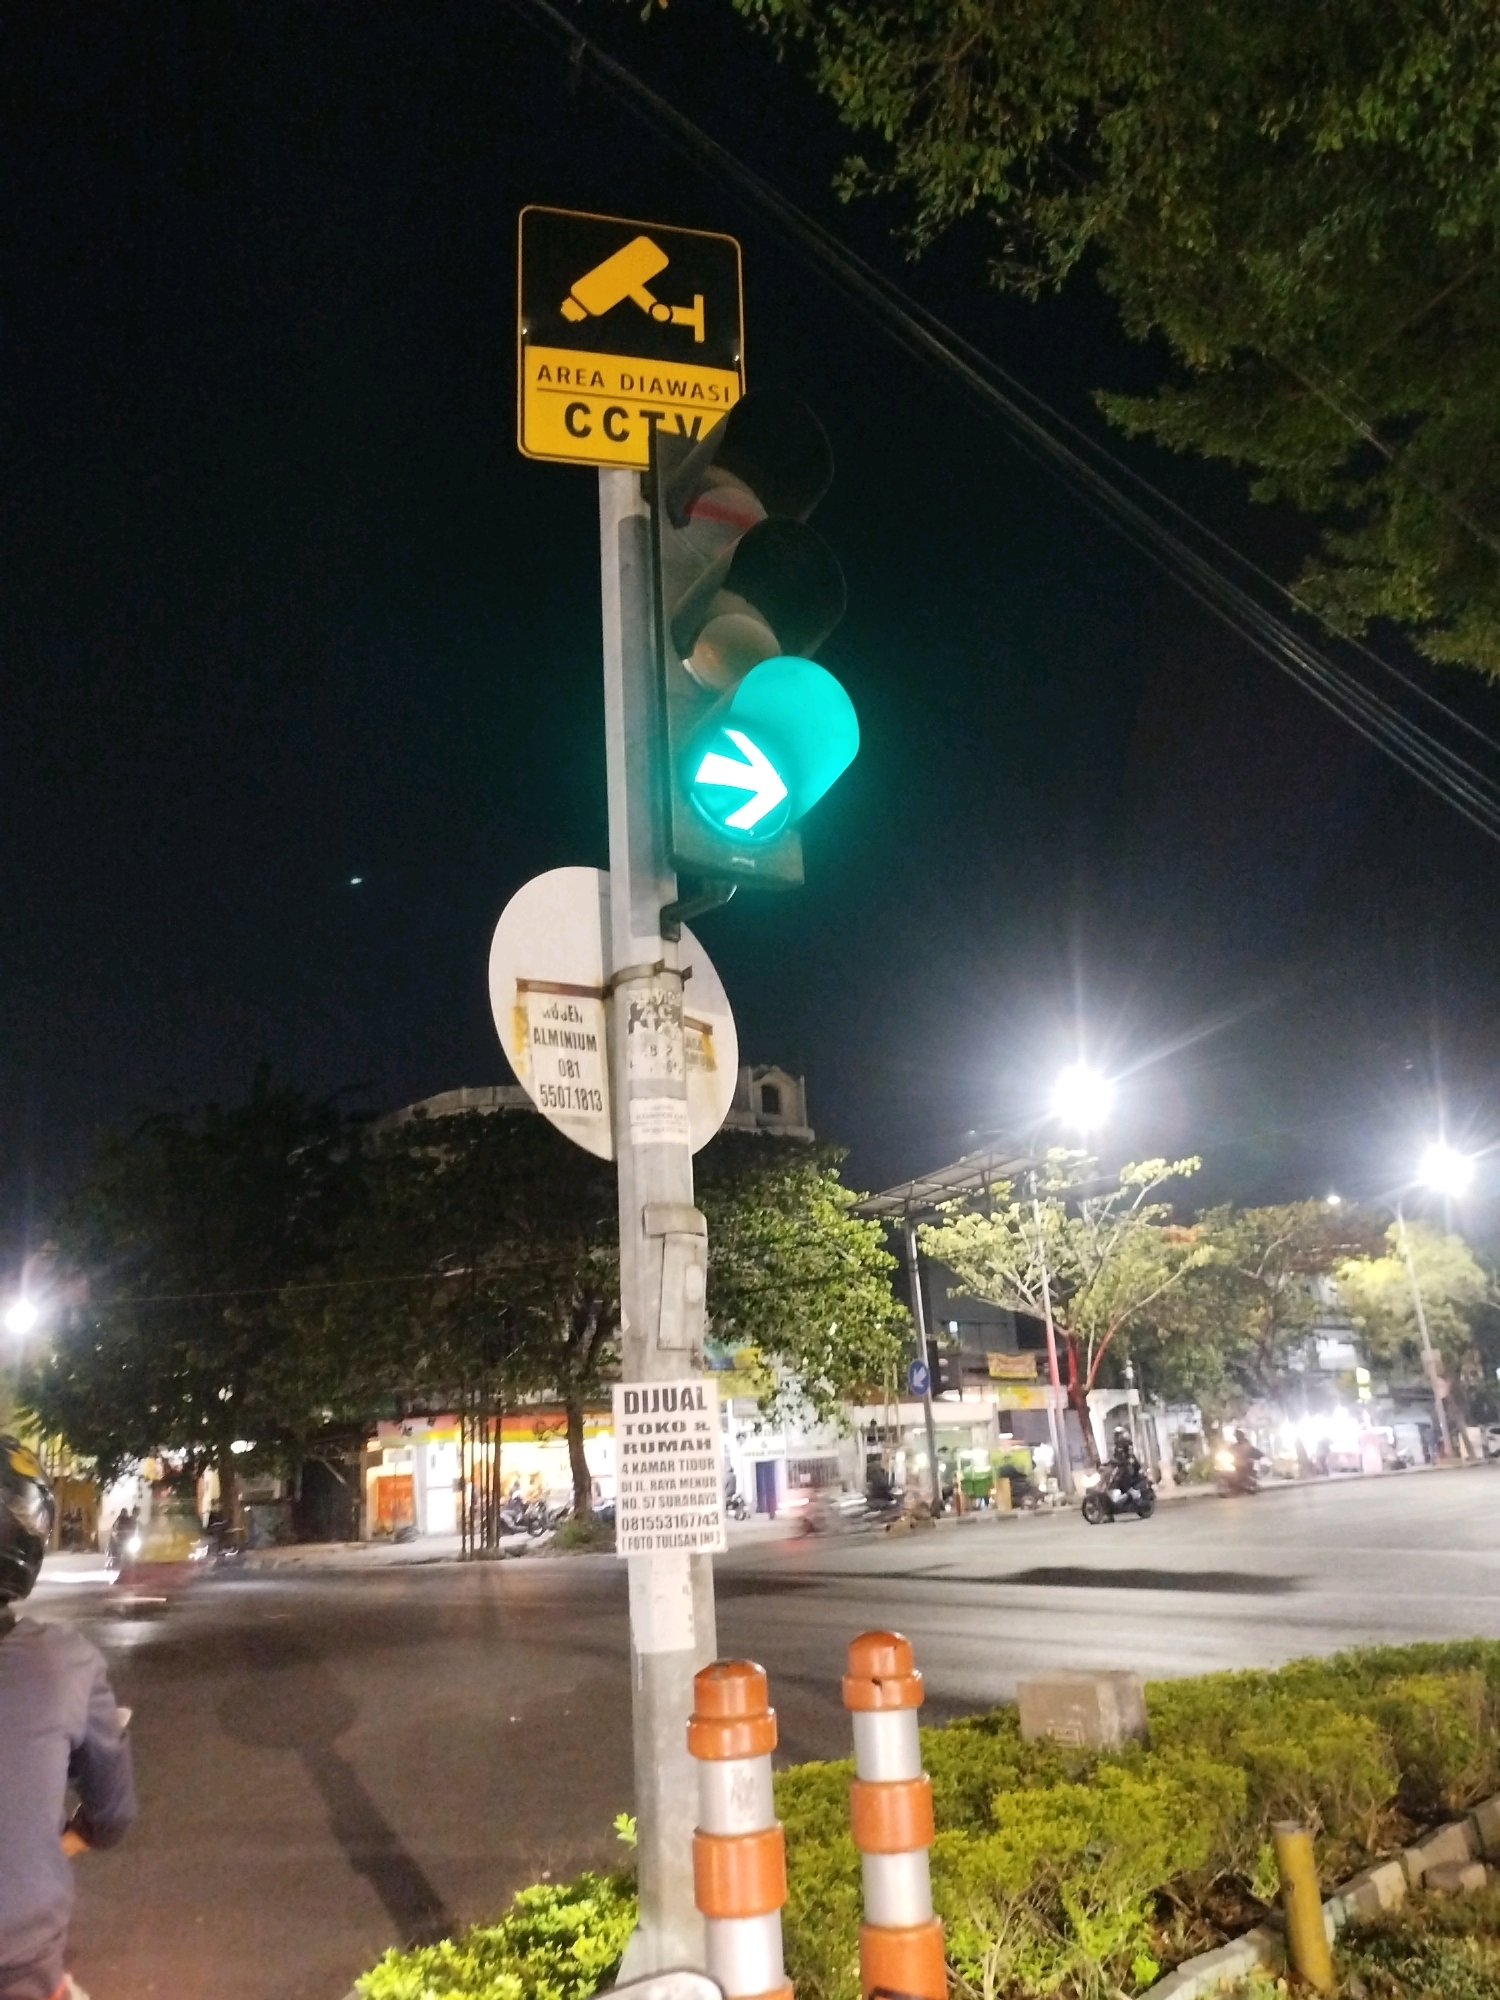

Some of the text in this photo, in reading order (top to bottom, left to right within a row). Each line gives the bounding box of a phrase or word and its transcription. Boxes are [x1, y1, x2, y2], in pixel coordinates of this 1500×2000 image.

[537, 364, 730, 403] AREA DIAWASI
[564, 401, 702, 442] CCTV
[533, 1027, 597, 1053] ALMINIUM
[558, 1058, 581, 1079] 081
[624, 1386, 708, 1415] DIJUAL
[623, 1421, 687, 1435] TOKO
[623, 1439, 711, 1455] RUMAH
[622, 1458, 715, 1475] 4 KAMAR TIDUR
[621, 1481, 632, 1492] DI
[650, 1478, 677, 1491] RAYA
[643, 1496, 656, 1509] 57
[658, 1493, 718, 1509] SURABAYA
[657, 1533, 697, 1549] TULISAN
